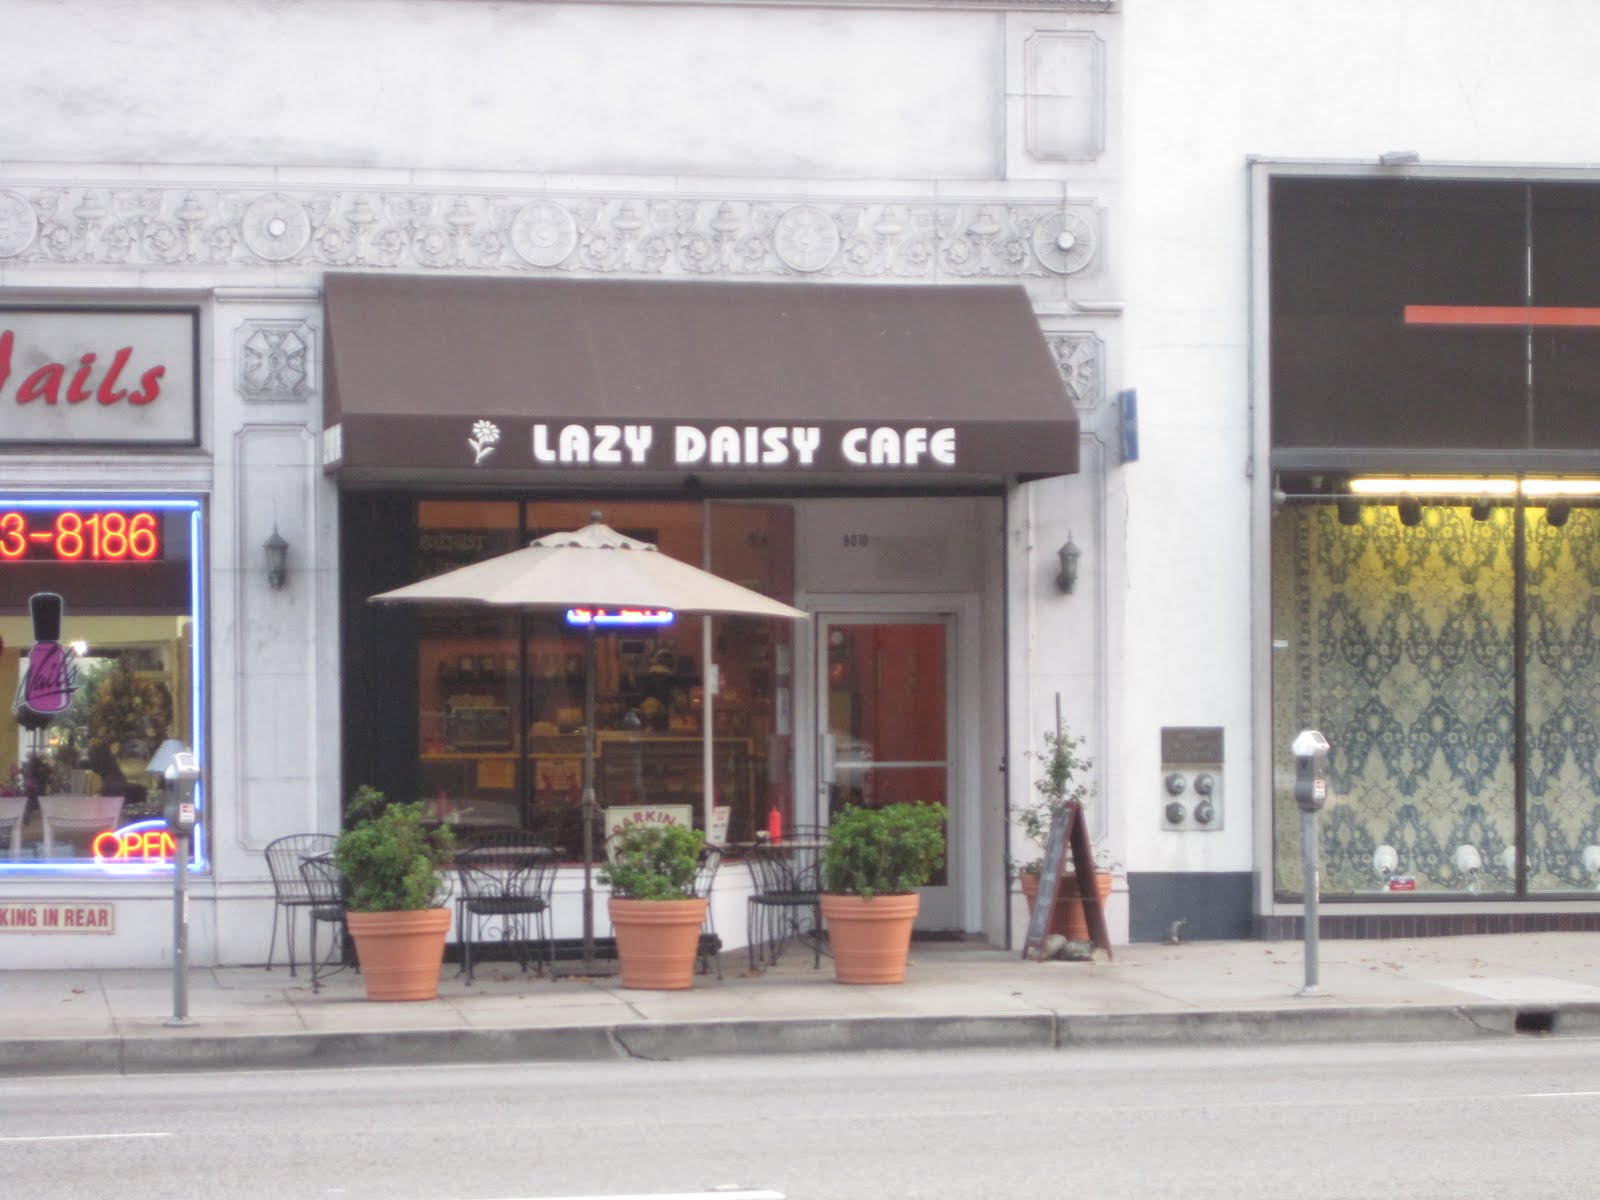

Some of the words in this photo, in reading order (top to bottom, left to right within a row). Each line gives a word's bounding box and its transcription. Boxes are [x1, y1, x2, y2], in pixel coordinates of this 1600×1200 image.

[533, 424, 653, 464] LAZY
[674, 425, 821, 465] DAISY
[841, 427, 957, 466] CAFE
[0, 511, 158, 558] 3-8186
[612, 811, 677, 836] PARKIN
[93, 830, 176, 863] OPEN
[43, 908, 59, 927] IN
[64, 908, 109, 927] REAR
